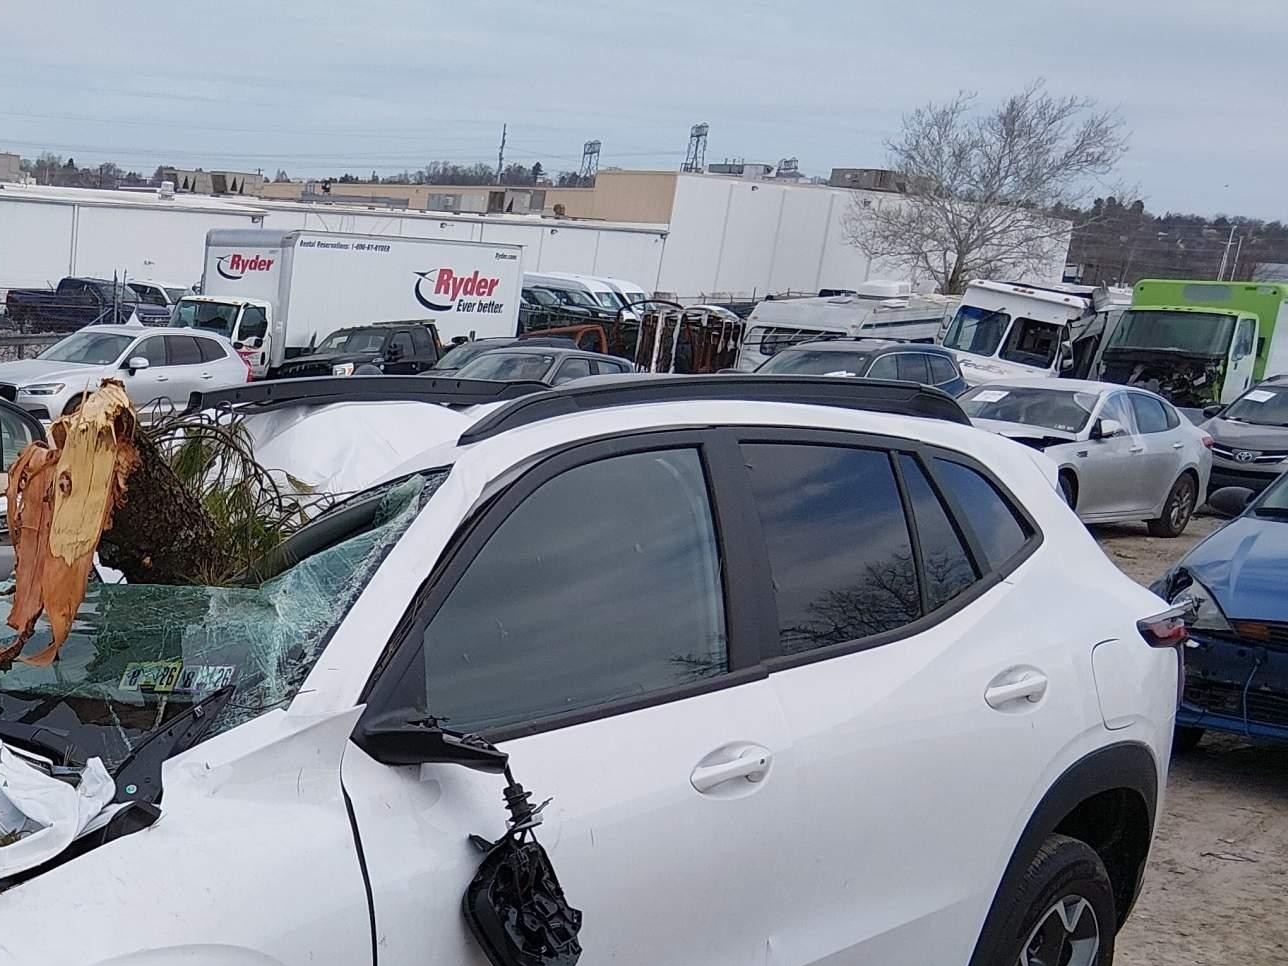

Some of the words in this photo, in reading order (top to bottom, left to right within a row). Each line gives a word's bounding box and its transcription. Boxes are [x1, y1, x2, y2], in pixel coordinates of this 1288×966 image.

[229, 254, 274, 275] Ryder
[434, 268, 500, 302] Ryder
[456, 299, 478, 313] Ever
[476, 300, 505, 314] better.
[158, 666, 177, 686] 26
